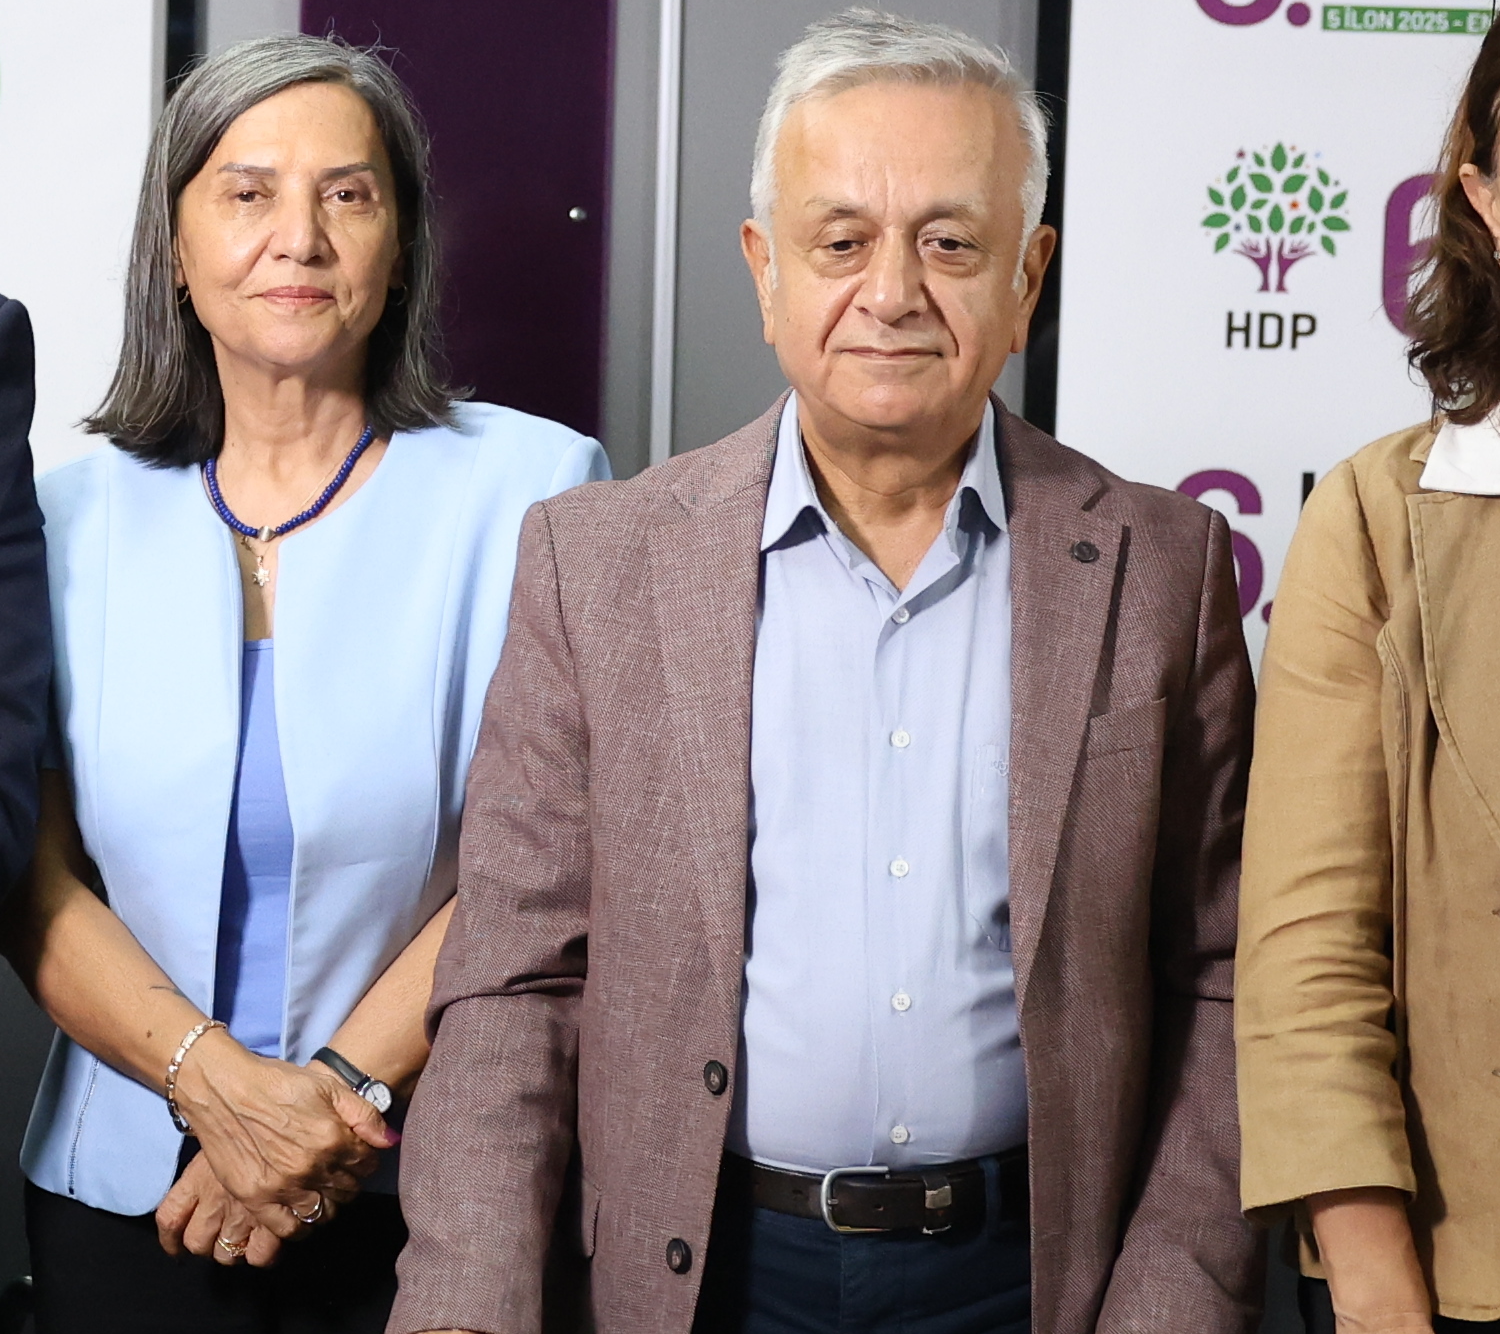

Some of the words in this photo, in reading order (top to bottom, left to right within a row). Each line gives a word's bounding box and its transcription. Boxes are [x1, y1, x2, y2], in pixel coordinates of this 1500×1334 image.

[1326, 8, 1341, 30] 5
[1397, 9, 1450, 33] 2025
[1225, 311, 1318, 350] HDP
